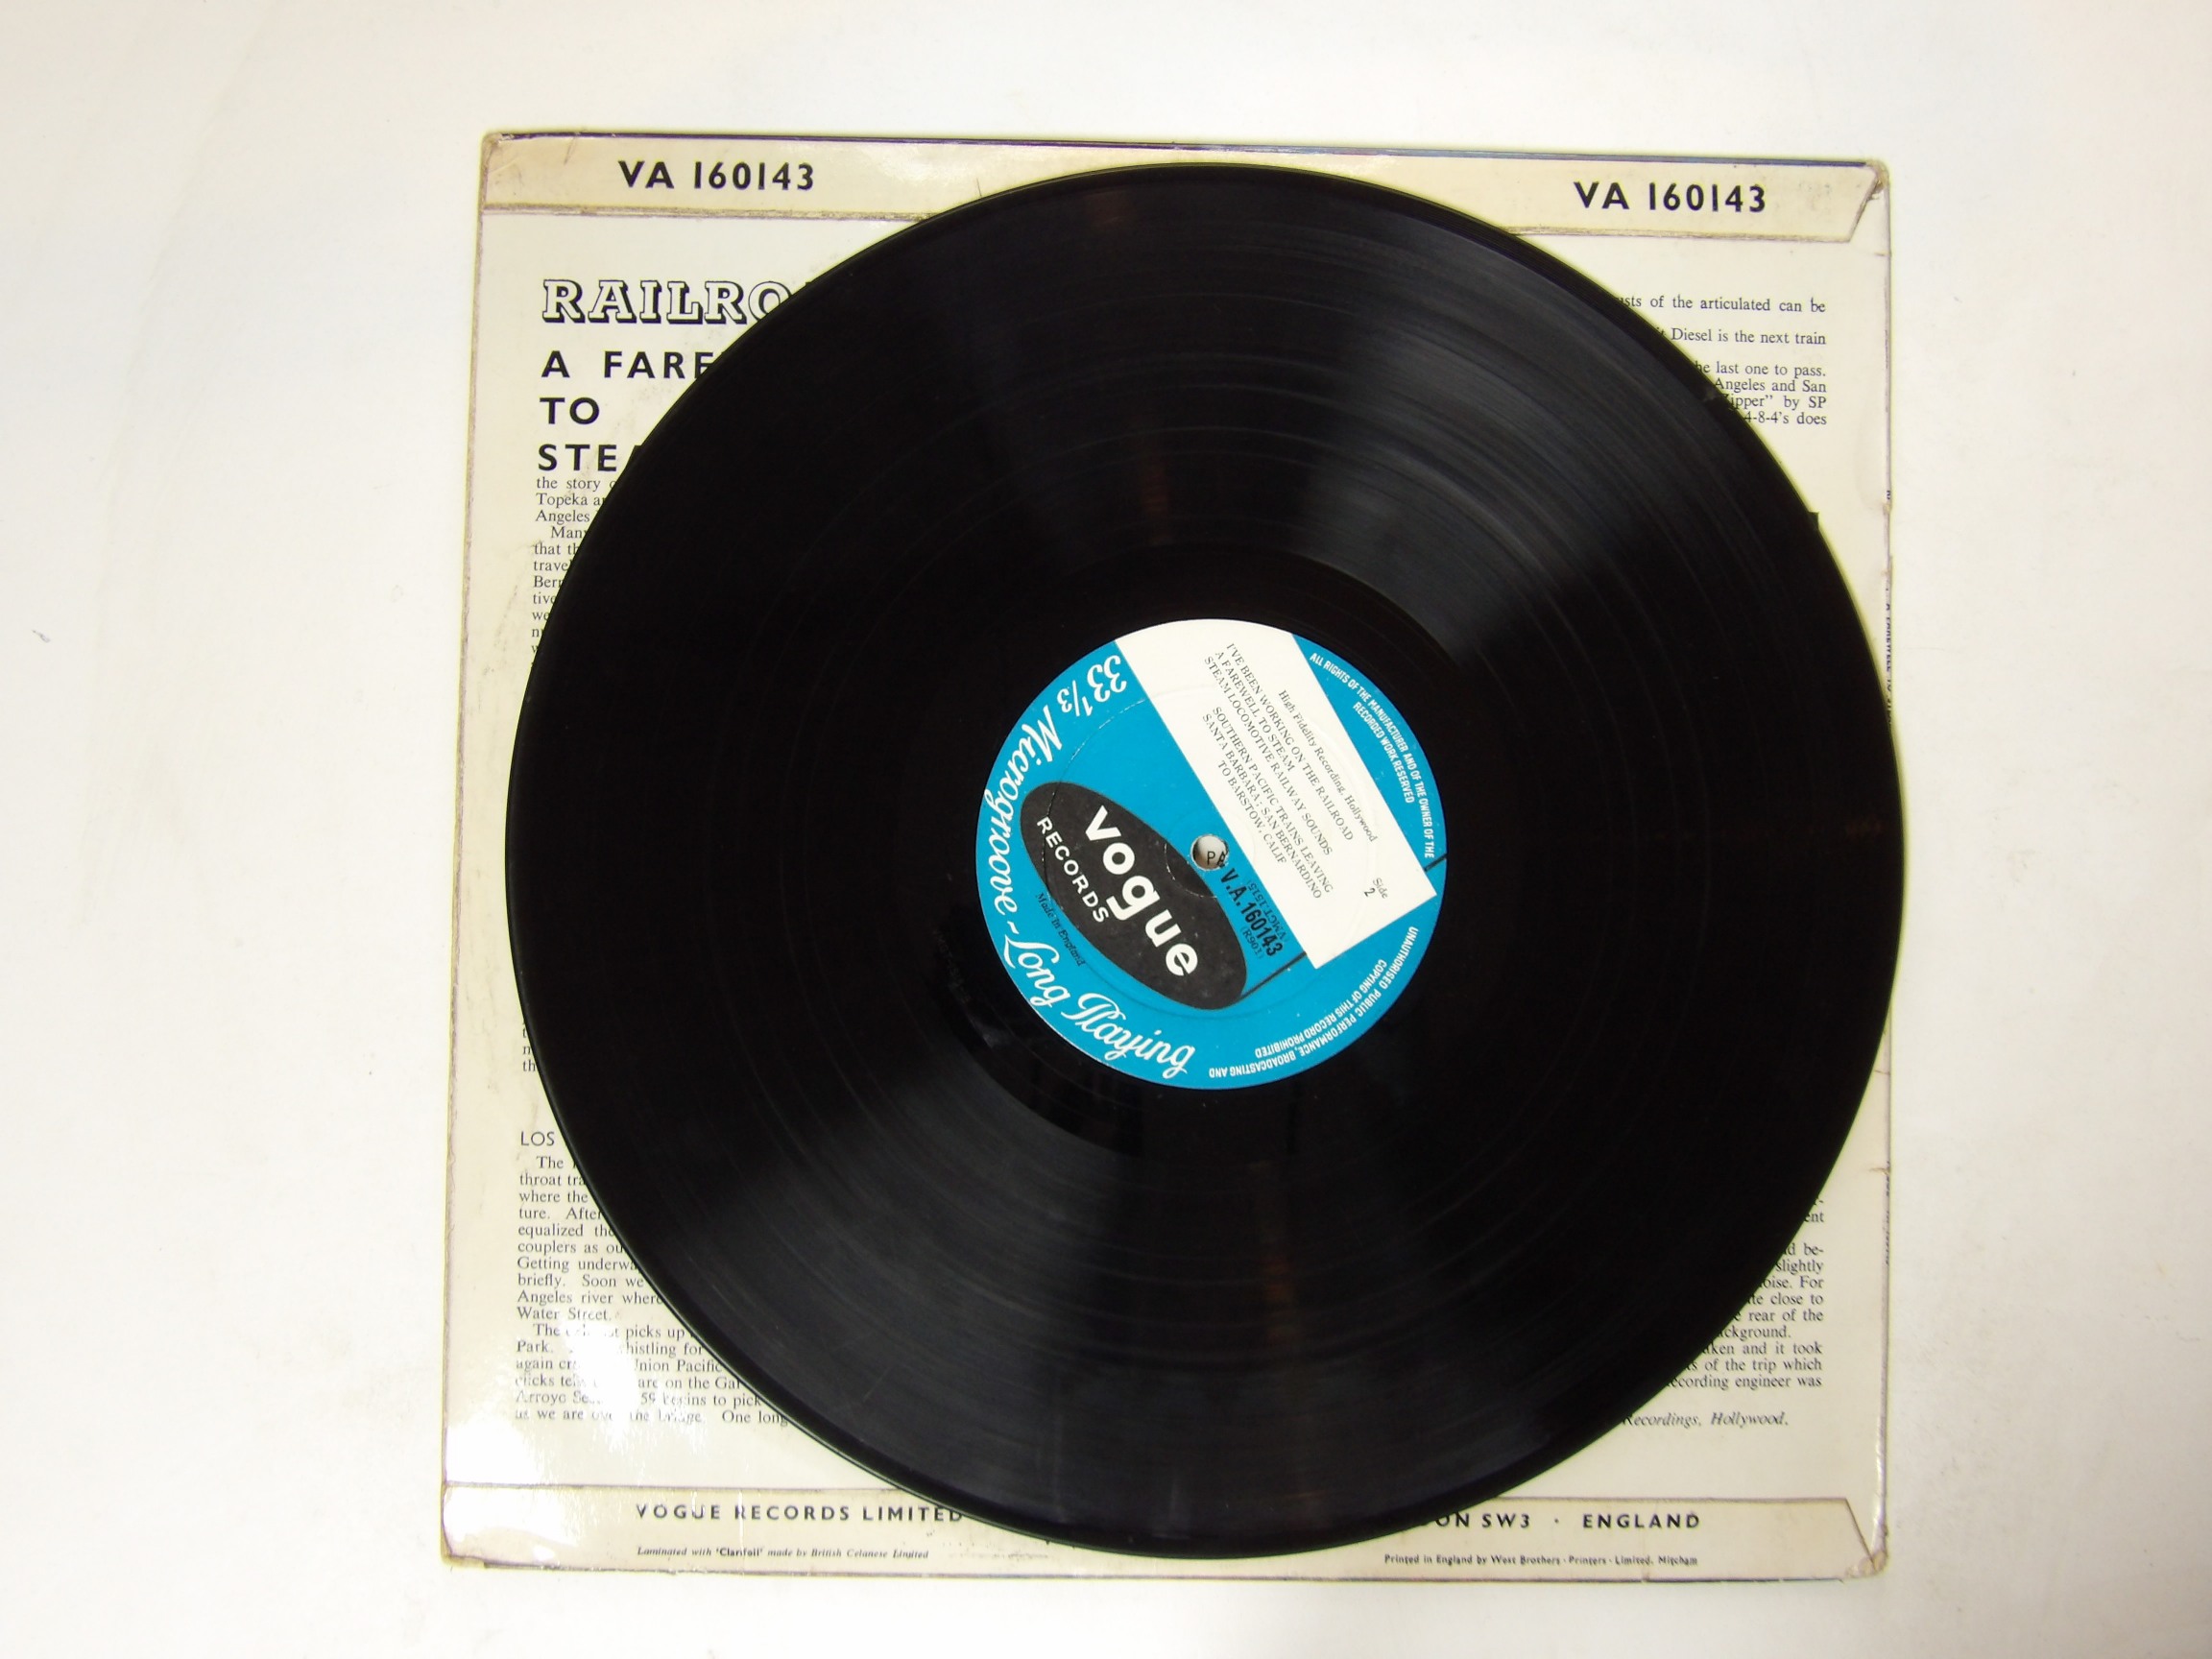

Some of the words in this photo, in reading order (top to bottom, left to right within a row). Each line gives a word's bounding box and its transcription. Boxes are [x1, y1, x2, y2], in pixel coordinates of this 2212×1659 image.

[618, 160, 673, 189] VA
[692, 161, 814, 190] 160143
[1574, 181, 1629, 210] VA
[1649, 182, 1766, 213] 160143
[541, 278, 796, 325] RAILRO
[1650, 296, 1665, 308] of
[1672, 294, 1693, 309] the
[1700, 297, 1770, 311] articulated
[1779, 301, 1802, 312] can
[1811, 297, 1826, 313] be
[1671, 327, 1713, 342] Diesel
[1718, 329, 1728, 342] is
[1735, 329, 1754, 343] the
[1760, 332, 1790, 344] next
[1795, 331, 1826, 345] train
[541, 350, 570, 379] A
[1716, 361, 1739, 374] last
[1745, 365, 1768, 374] one
[1774, 364, 1788, 375] to
[1794, 365, 1826, 379] pass.
[1715, 377, 1766, 393] Angeles
[1771, 379, 1795, 392] and
[1802, 380, 1826, 393] San
[540, 397, 600, 425] TO
[1784, 397, 1799, 410] by
[1809, 396, 1826, 409] SP
[1796, 411, 1827, 424] does
[536, 476, 558, 489] the
[566, 478, 601, 492] story
[536, 493, 588, 508] Topeka
[536, 510, 590, 525] Angeles
[534, 543, 561, 555] that
[1310, 653, 1324, 666] ALL
[1087, 655, 1127, 703] 33
[1323, 661, 1350, 684] RIGHTS
[1348, 679, 1359, 690] OF
[1357, 686, 1372, 702] THE
[1221, 660, 1260, 717] FAREWELL
[1258, 716, 1271, 733] TO
[1267, 733, 1295, 771] STEAM
[1368, 699, 1408, 753] MANUFACTURER
[1204, 656, 1231, 693] STEAM
[1227, 692, 1274, 761] LOCOMOTIVE
[1270, 761, 1306, 810] RAILWAY
[1301, 812, 1332, 854] SOUNDS
[1239, 664, 1262, 694] BEEN
[1260, 694, 1294, 745] WORKING
[1290, 746, 1305, 762] ON
[1302, 762, 1319, 785] THE
[1315, 785, 1353, 839] RAILROAD
[1353, 702, 1385, 738] RECORDED
[1380, 735, 1399, 761] WORK
[1392, 760, 1415, 804] RESERVED
[1217, 759, 1231, 776] TO
[1278, 689, 1295, 712] High
[1292, 712, 1316, 746] Fidelity
[1344, 795, 1378, 841] Hollywood
[1403, 754, 1417, 770] AND
[1410, 770, 1421, 781] OF
[1414, 781, 1427, 797] THE
[1202, 713, 1227, 750] SANTA
[1261, 806, 1279, 830] SAN
[1275, 829, 1321, 898] BERNARDINO
[1213, 707, 1252, 763] SOUTHERN
[1248, 763, 1278, 805] PACIFIC
[1275, 805, 1303, 845] TRAINS
[1300, 846, 1333, 892] LEAVING
[983, 705, 1063, 915] Microgroove
[1419, 799, 1433, 828] OWNER
[1424, 829, 1433, 839] OF
[1424, 841, 1434, 858] THE
[1037, 816, 1109, 923] RECORDS
[1085, 805, 1198, 976] vogue
[1364, 887, 1376, 898] 2
[1373, 878, 1388, 899] Side
[1036, 892, 1054, 918] Made
[1058, 929, 1086, 967] England
[1379, 926, 1419, 989] UNAUTHORISED
[1359, 959, 1386, 995] COPYING
[1351, 990, 1362, 1004] OF
[1355, 989, 1382, 1017] PUBLIC
[1003, 934, 1070, 1008] Long
[1061, 993, 1195, 1079] Playing
[1336, 999, 1354, 1018] THIS
[1305, 1010, 1336, 1038] RECORD
[1255, 1034, 1305, 1058] PROHIBITED
[1230, 1050, 1296, 1077] BROADCASTING
[1209, 1067, 1228, 1078] AND
[521, 1131, 555, 1146] LOS
[537, 1156, 564, 1168] The
[519, 1173, 562, 1186] throat
[519, 1190, 561, 1203] where
[567, 1190, 589, 1203] the
[519, 1208, 551, 1219] ture.
[518, 1223, 584, 1238] equalized
[518, 1240, 576, 1256] couplers
[584, 1244, 598, 1253] as
[1804, 1243, 1824, 1256] be-
[517, 1256, 569, 1273] Getting
[1776, 1260, 1824, 1275] slightly
[518, 1273, 565, 1289] briefly.
[582, 1274, 616, 1287] Soon
[626, 1278, 644, 1287] we
[1800, 1275, 1824, 1288] For
[517, 1289, 572, 1306] Angeles
[581, 1291, 613, 1304] river
[1770, 1292, 1803, 1305] close
[1811, 1293, 1824, 1305] to
[517, 1307, 560, 1319] Water
[1748, 1312, 1775, 1322] rear
[1782, 1309, 1797, 1322] of
[1803, 1309, 1824, 1321] the
[533, 1324, 561, 1336] The
[626, 1324, 661, 1340] picks
[668, 1329, 685, 1340] up
[1743, 1342, 1767, 1355] and
[1776, 1342, 1785, 1355] it
[1792, 1341, 1822, 1355] took
[1704, 1358, 1720, 1371] of
[1725, 1358, 1745, 1371] the
[1752, 1358, 1776, 1373] trip
[1783, 1358, 1822, 1371] which
[688, 1377, 710, 1389] the
[1735, 1375, 1791, 1390] engineer
[1798, 1377, 1821, 1387] was
[713, 1395, 727, 1406] to
[538, 1409, 555, 1420] we
[722, 1409, 751, 1423] One
[637, 1503, 720, 1520] VOGUE
[734, 1504, 849, 1521] RECORDS
[1482, 1513, 1530, 1528] SW3
[1583, 1513, 1699, 1528] ENGLAND
[637, 1547, 687, 1557] Laminated
[692, 1548, 711, 1556] with
[768, 1549, 793, 1557] made
[1384, 1554, 1419, 1565] Printed
[1436, 1554, 1473, 1566] England
[1477, 1554, 1487, 1565] by
[1491, 1555, 1516, 1565] West
[1520, 1555, 1560, 1565] Brothers
[1569, 1555, 1606, 1566] Printers
[1659, 1555, 1697, 1566] Mitcham
